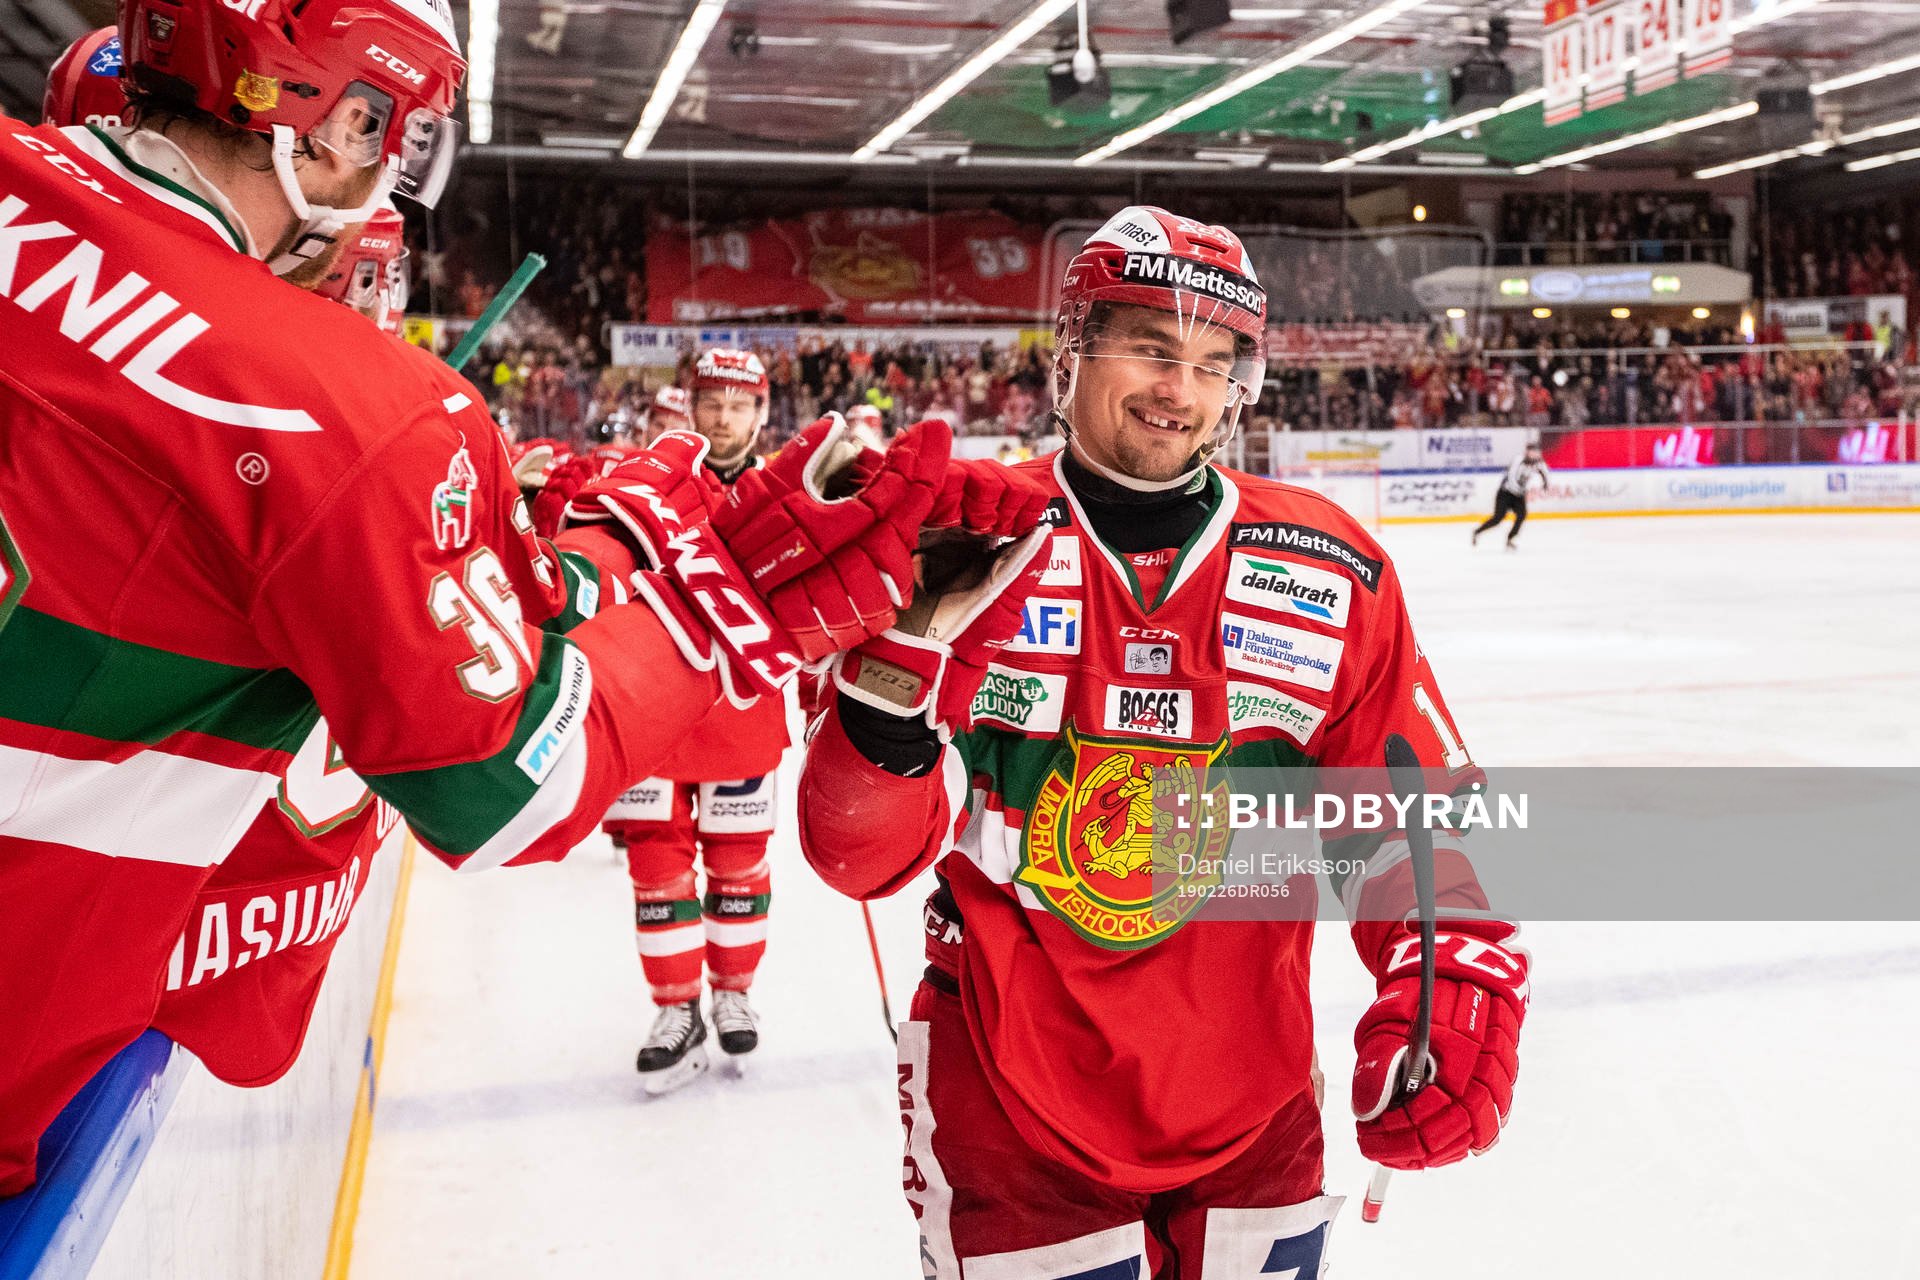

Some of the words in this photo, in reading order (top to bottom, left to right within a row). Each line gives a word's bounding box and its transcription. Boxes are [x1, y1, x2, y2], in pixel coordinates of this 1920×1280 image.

[1594, 16, 1614, 66] 17
[365, 43, 426, 85] CCM
[1552, 35, 1570, 83] 14
[12, 132, 123, 203] CCM
[360, 237, 392, 249] CCM
[968, 237, 1028, 278] 35
[1123, 254, 1165, 280] FM
[1167, 262, 1262, 314] Mattsson
[1387, 492, 1470, 504] SPORT
[1388, 480, 1475, 491] JOHNS
[1132, 555, 1168, 567] SHL
[1236, 527, 1274, 543] FM
[1276, 527, 1374, 582] Mattsson
[1240, 572, 1339, 608] dalakraft
[427, 546, 536, 704] 36
[1119, 626, 1180, 640] CCM
[1246, 629, 1294, 650] Dalarnas
[1244, 640, 1332, 675] Försäkringsbolag
[555, 655, 587, 734] moramast
[863, 666, 914, 691] CCM
[972, 695, 1030, 722] BUDDY
[1119, 689, 1180, 729] BOGGS
[1249, 706, 1309, 733] Electric
[1117, 723, 1152, 732] GRUS
[1161, 728, 1178, 736] AB
[709, 809, 767, 818] SPORT
[1034, 788, 1062, 866] MORA
